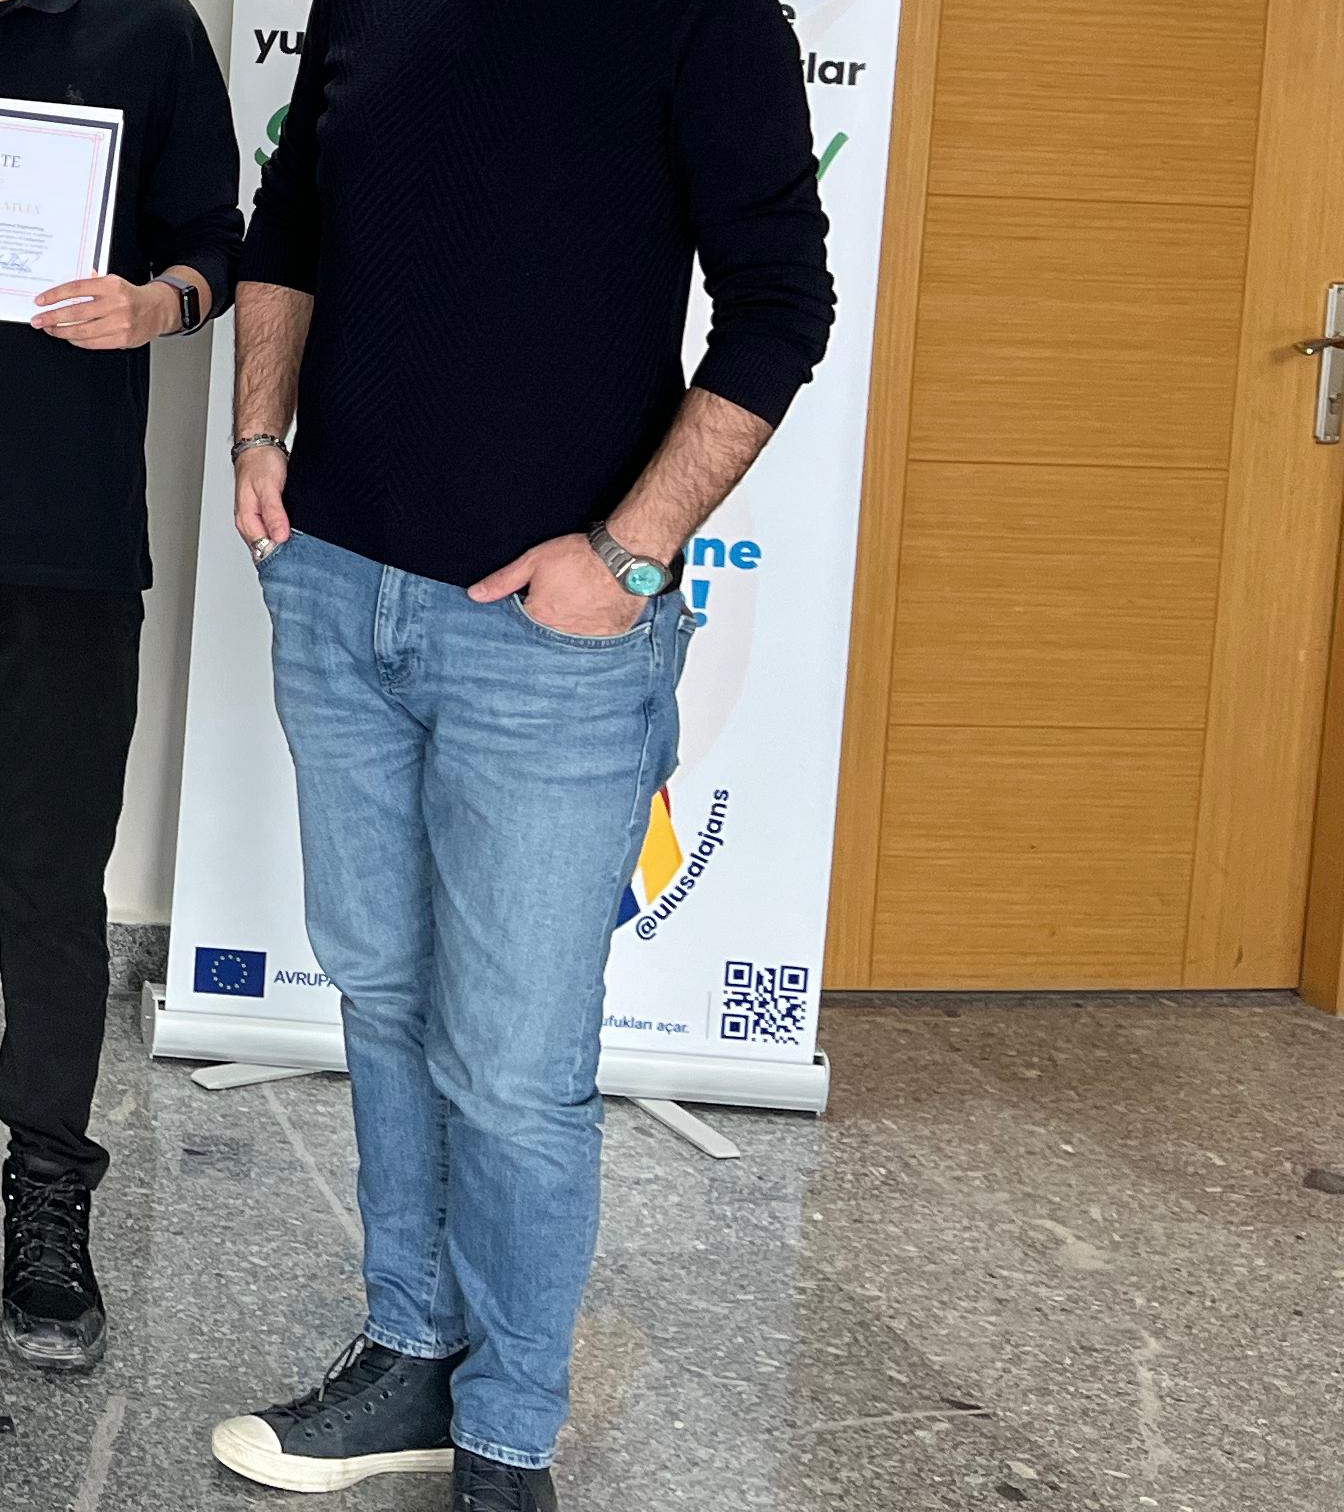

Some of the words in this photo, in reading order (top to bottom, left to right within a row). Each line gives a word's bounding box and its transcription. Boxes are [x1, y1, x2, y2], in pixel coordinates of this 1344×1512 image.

[801, 52, 867, 86] lar
[635, 788, 729, 941] @ulusalajans
[656, 1020, 690, 1035] açar.
